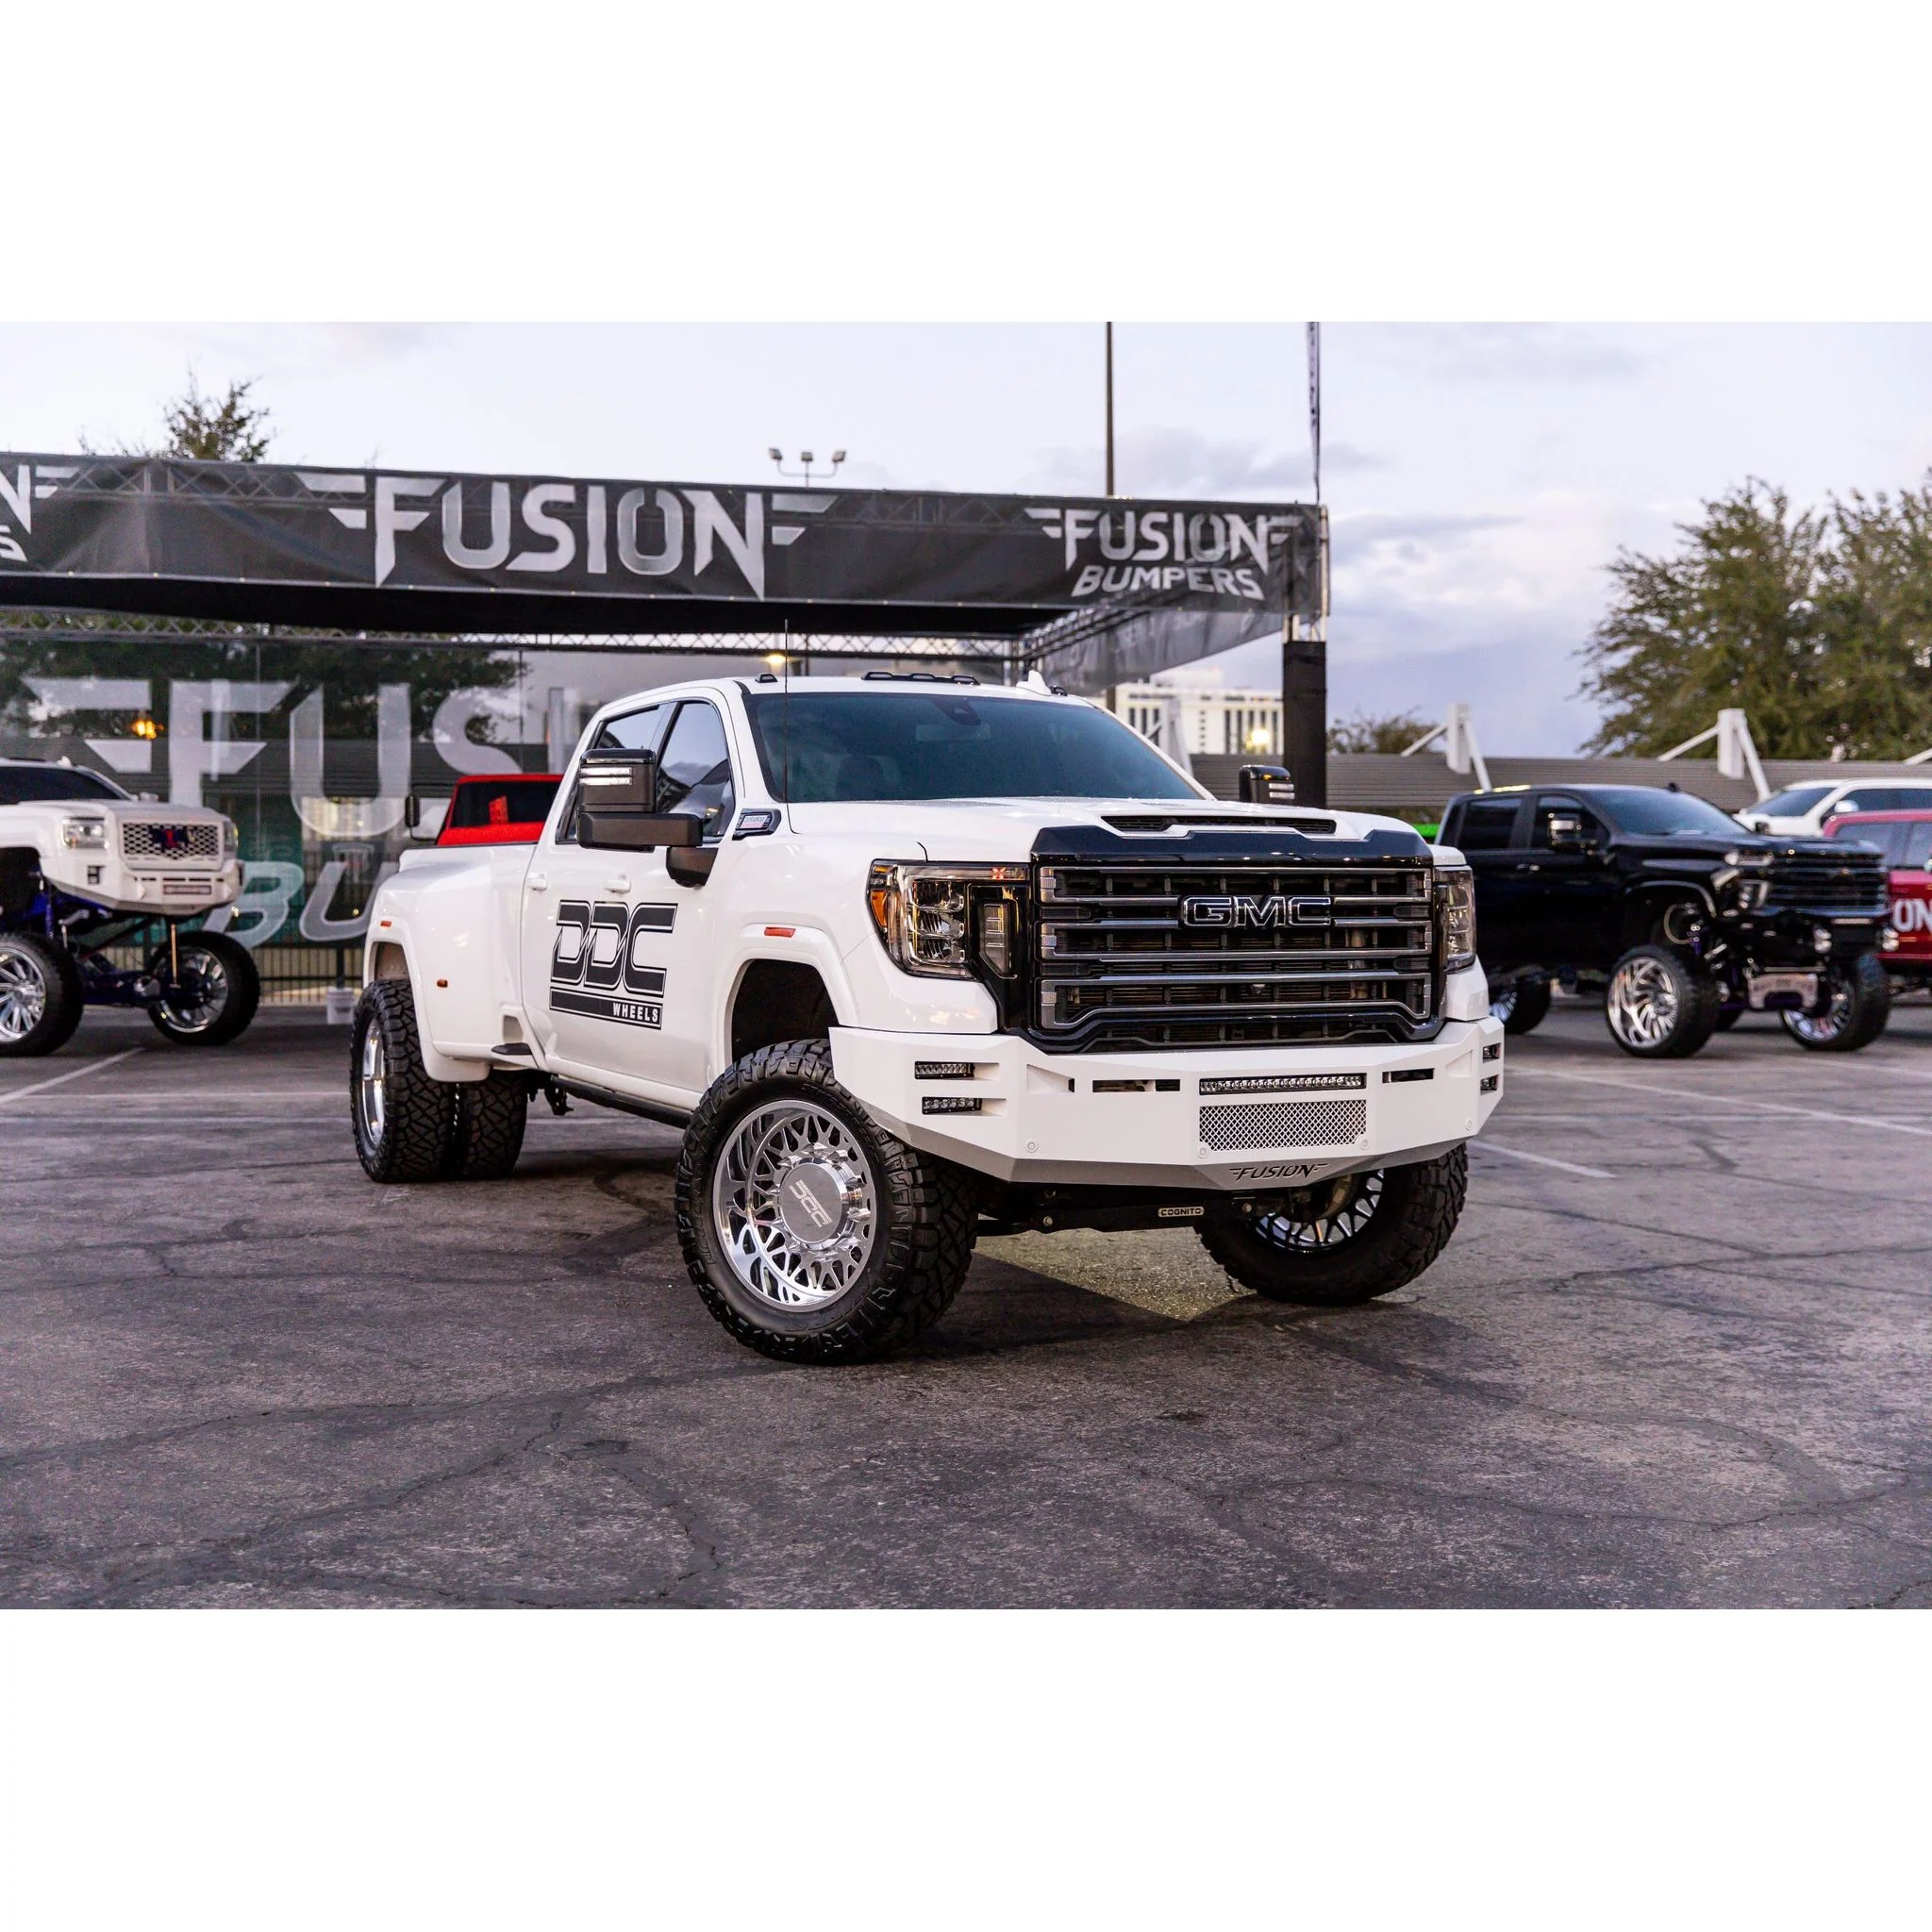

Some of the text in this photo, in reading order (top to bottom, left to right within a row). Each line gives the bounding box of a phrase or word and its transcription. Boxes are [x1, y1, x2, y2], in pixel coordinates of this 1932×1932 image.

[375, 475, 766, 601] FUSION
[1063, 508, 1270, 575] FUSION
[1071, 565, 1265, 601] BUMPERS
[1181, 894, 1332, 927] GMC
[551, 899, 678, 998] DDC
[612, 1002, 659, 1023] WHEELS
[1235, 1163, 1317, 1182] FUSION
[1160, 1208, 1202, 1216] COGNITO
